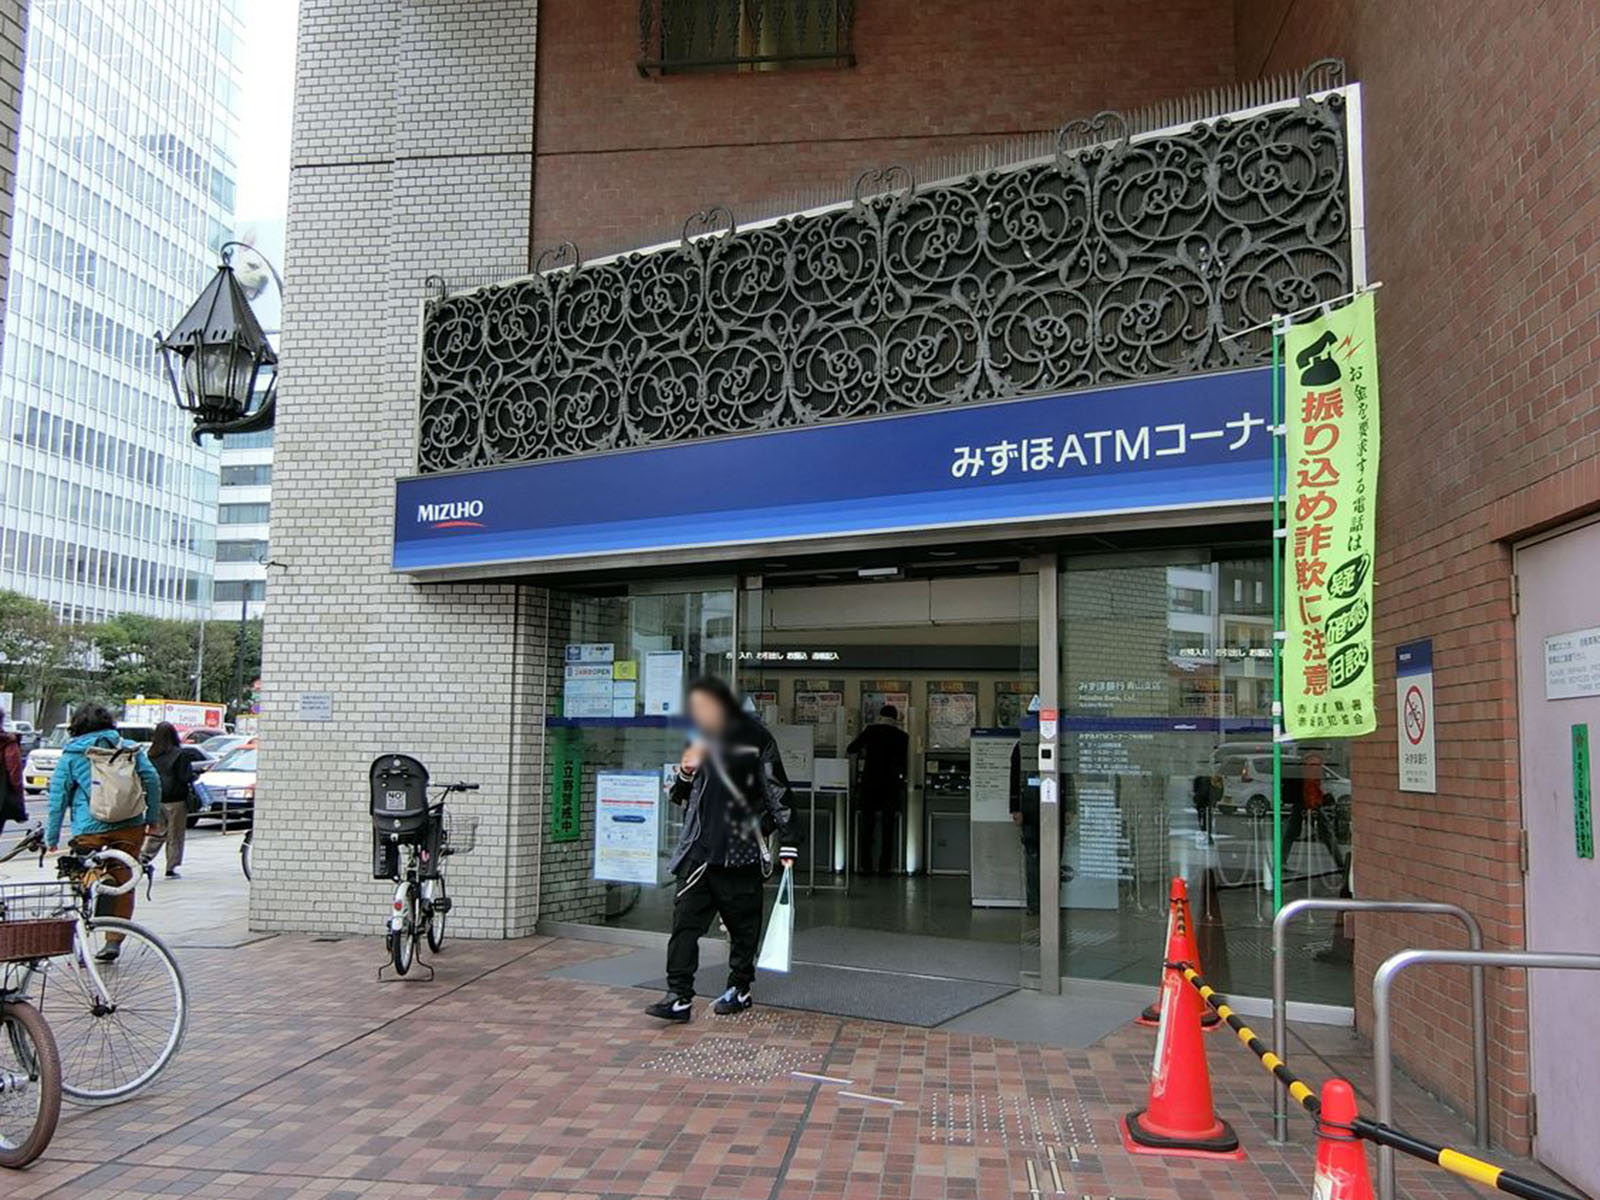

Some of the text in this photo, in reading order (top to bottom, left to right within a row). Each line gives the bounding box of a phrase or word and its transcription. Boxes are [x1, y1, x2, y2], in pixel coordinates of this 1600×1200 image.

[951, 412, 1273, 477] みずほATMコーナ
[417, 500, 484, 522] MIZUHO
[1294, 387, 1344, 696] 振り込め詐欺に注意
